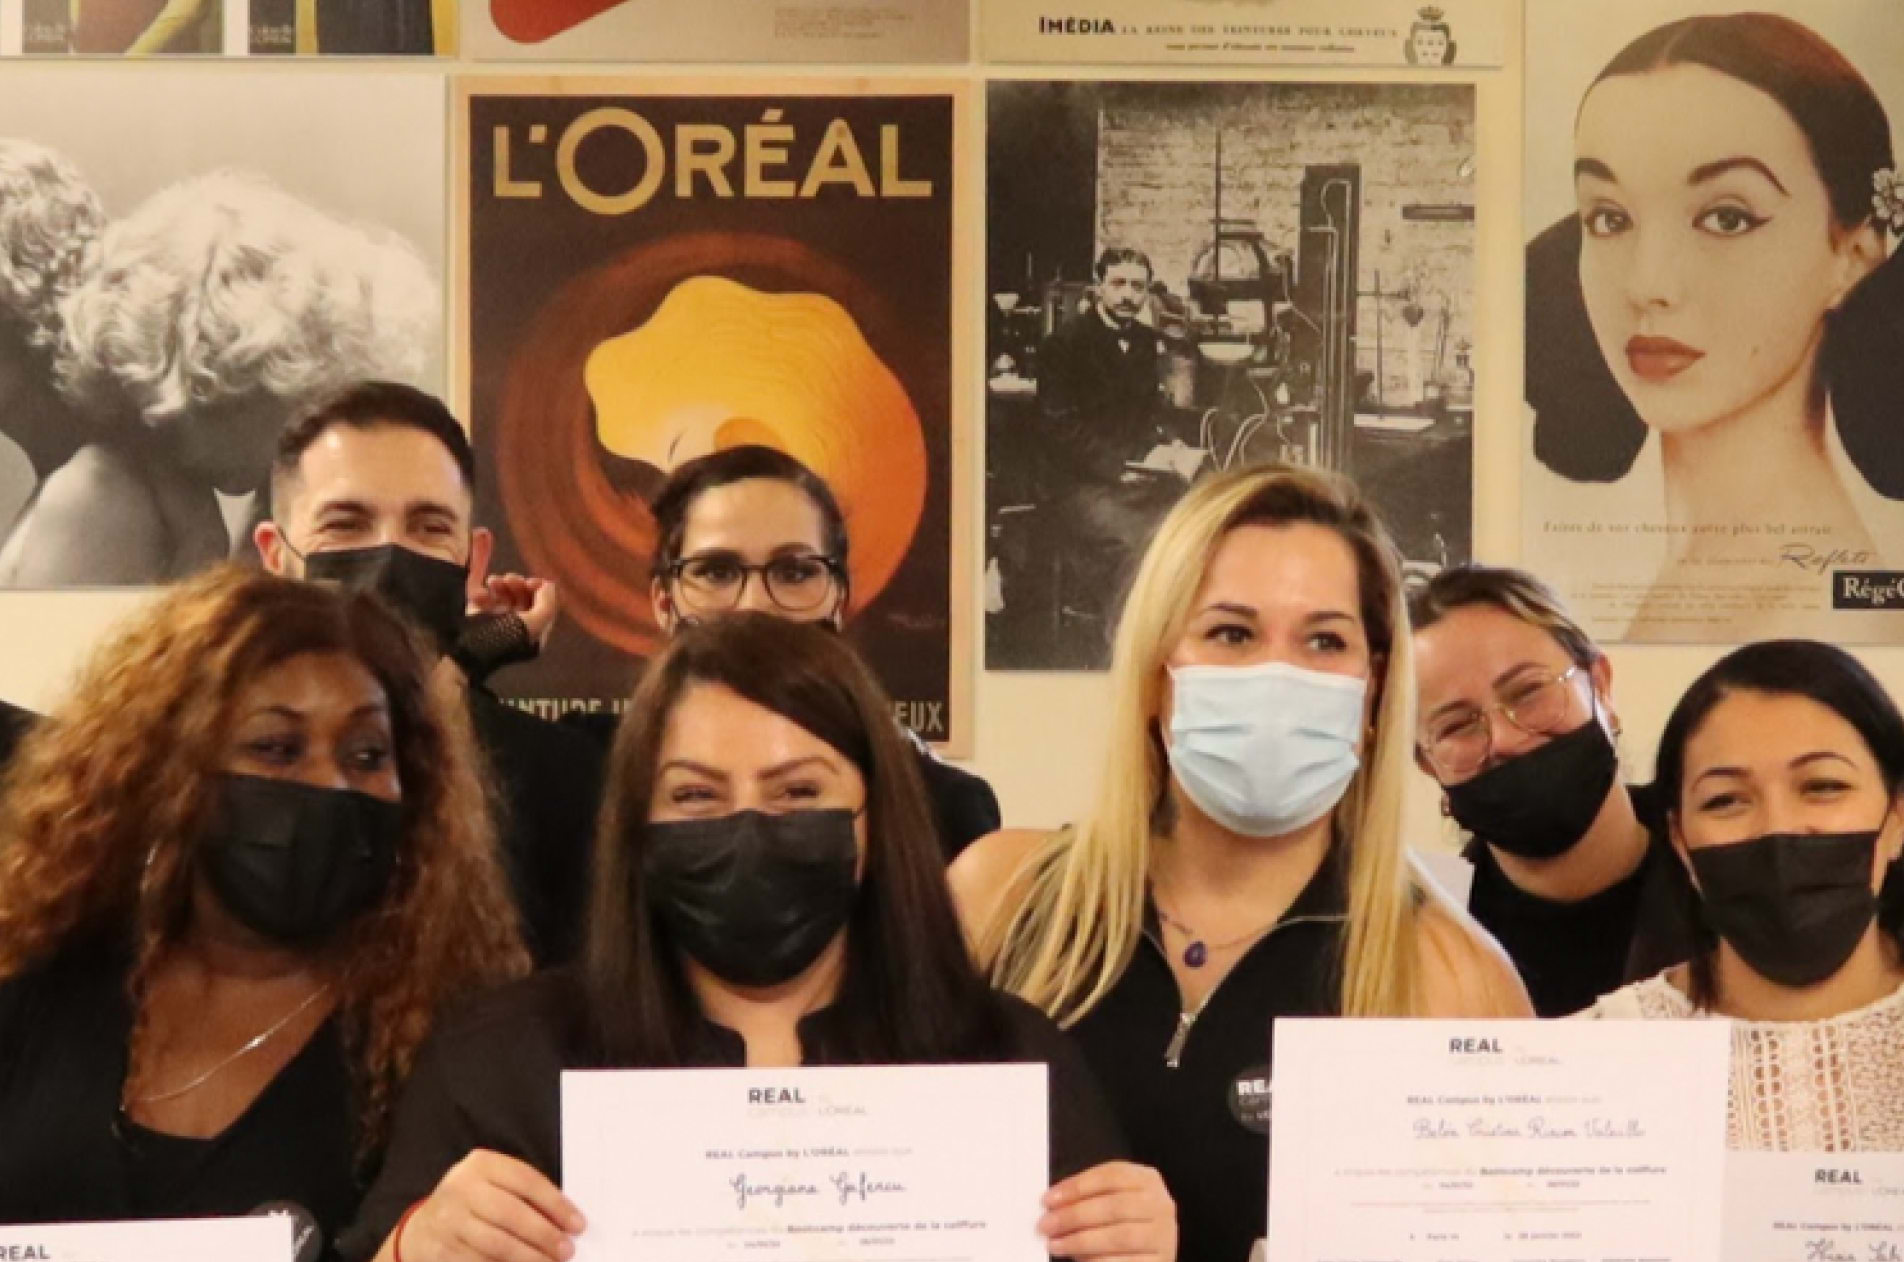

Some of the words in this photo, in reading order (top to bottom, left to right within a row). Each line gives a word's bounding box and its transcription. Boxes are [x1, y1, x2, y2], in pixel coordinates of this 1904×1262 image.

[1039, 15, 1115, 35] IMÉDIA
[493, 106, 932, 215] L'ORÉAL
[1449, 1038, 1503, 1054] REAL
[748, 1087, 806, 1104] REAL
[1815, 1169, 1862, 1185] REAL
